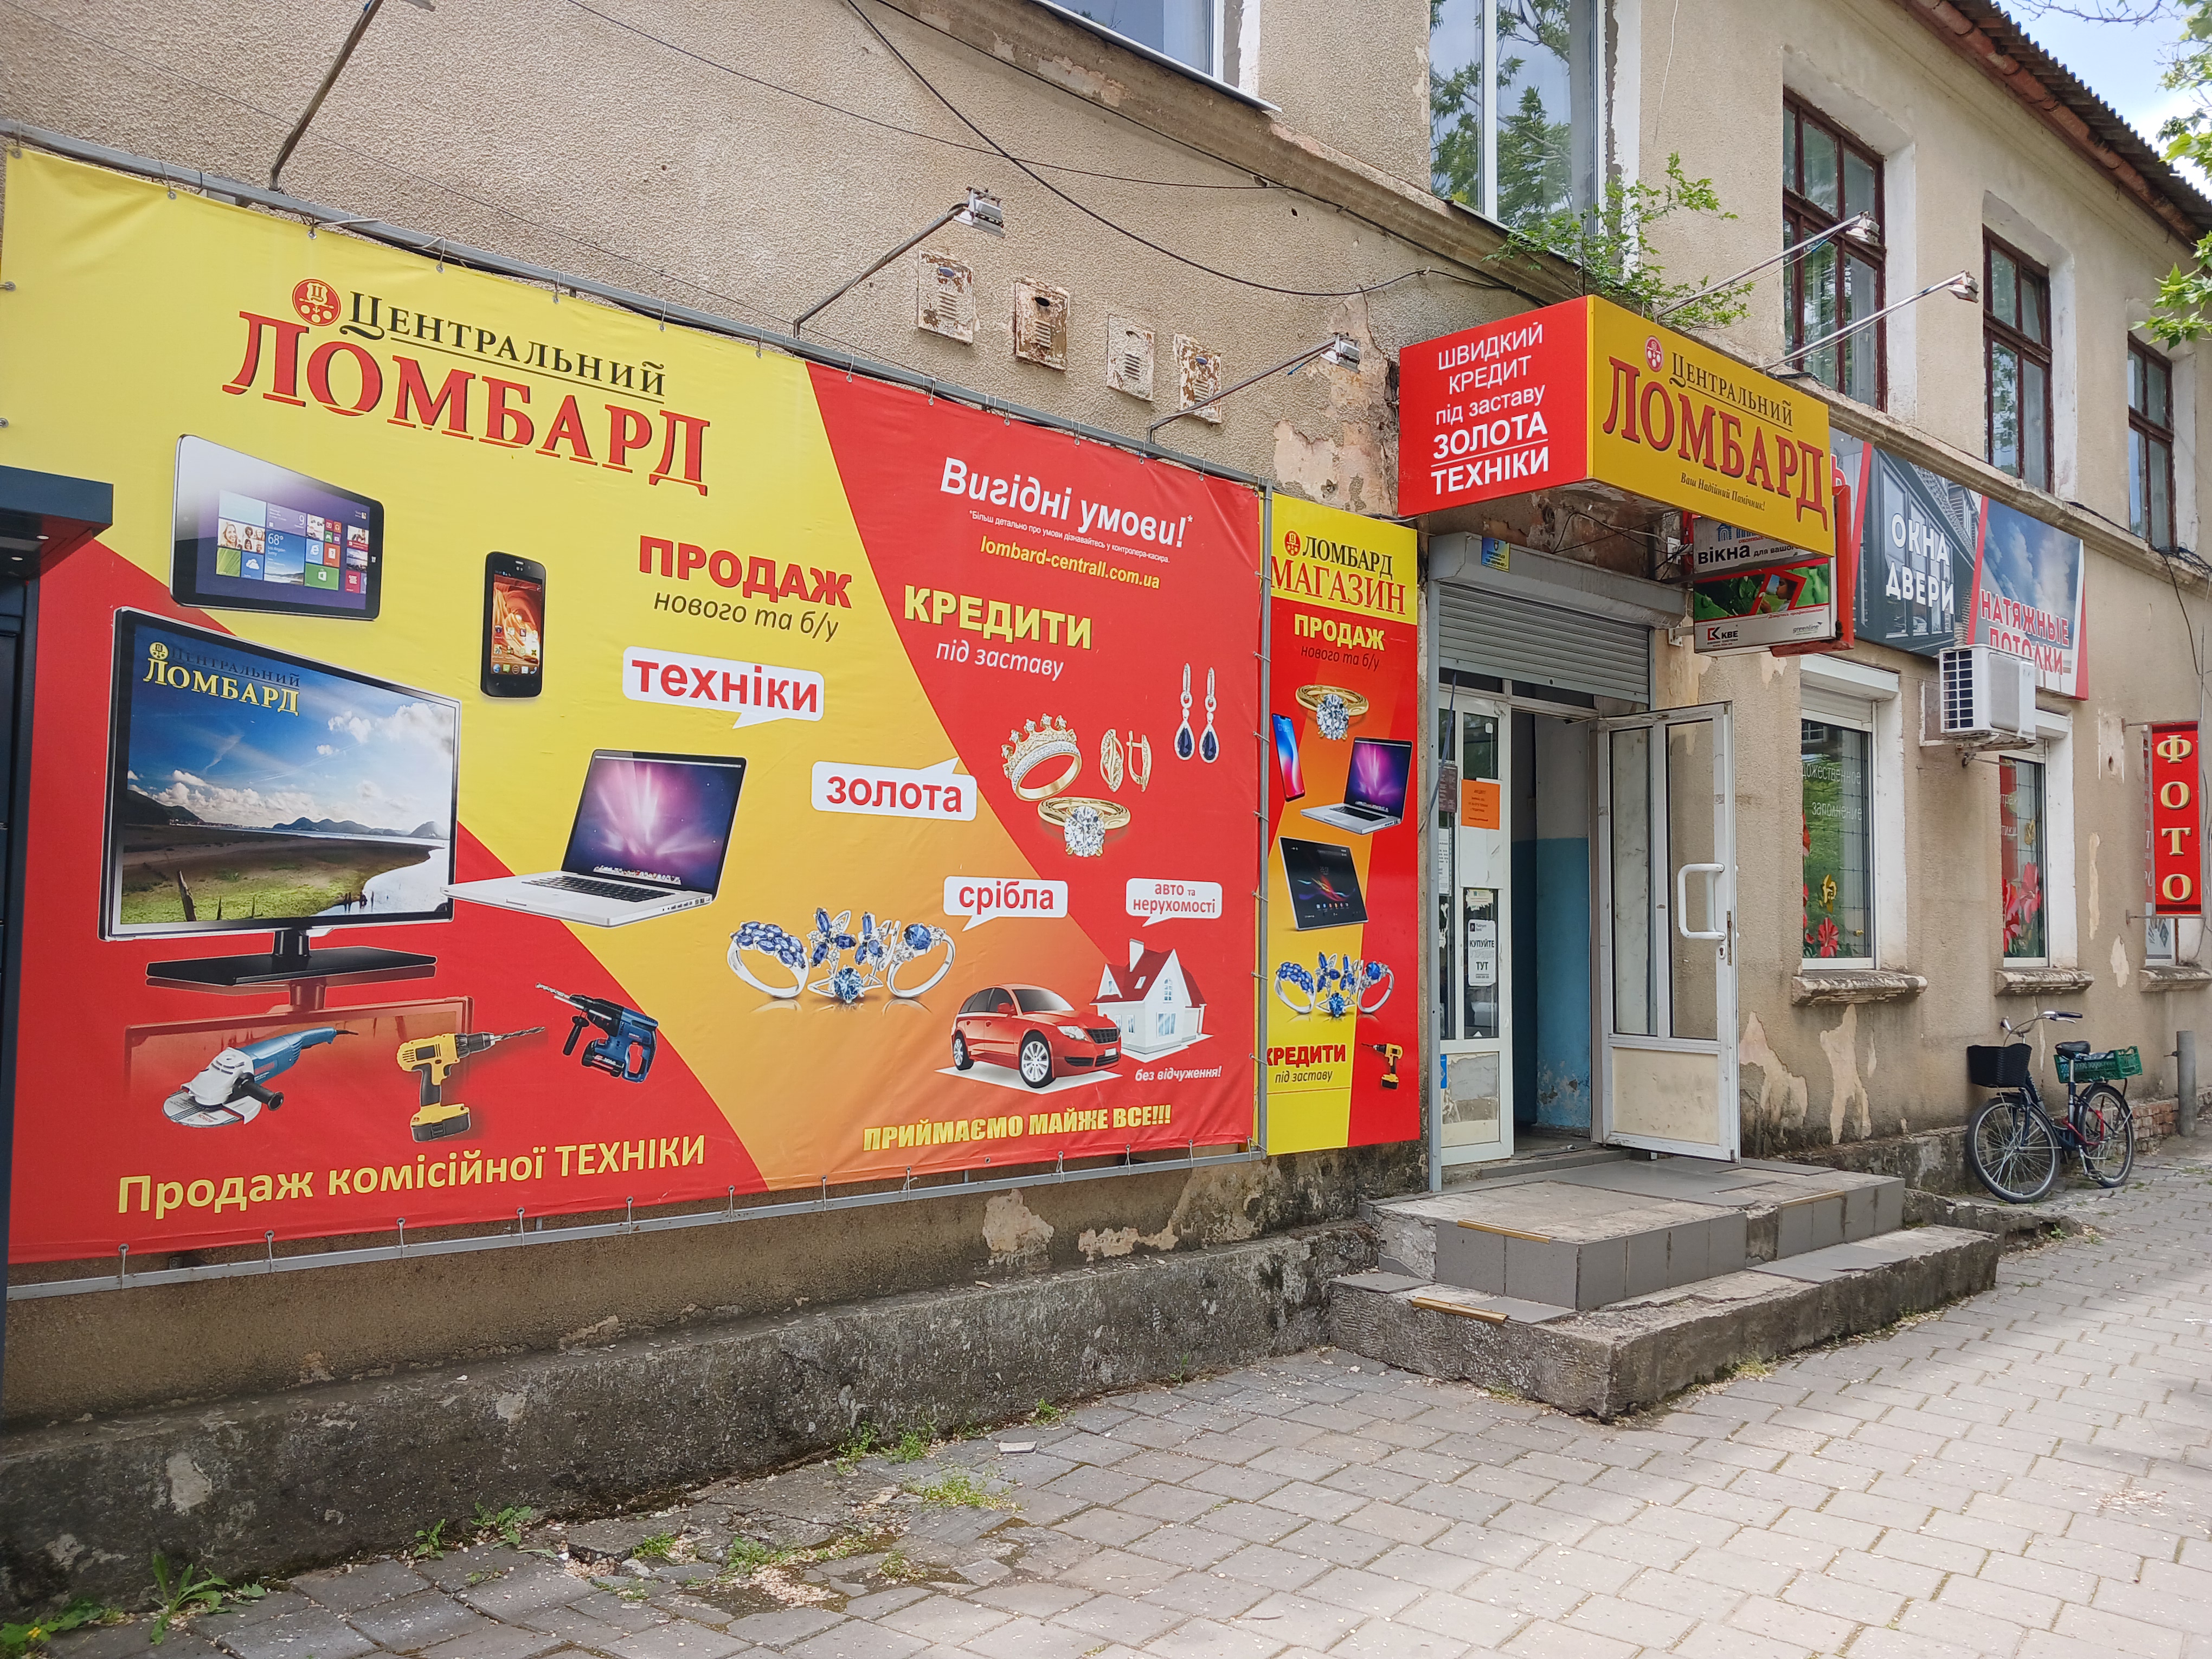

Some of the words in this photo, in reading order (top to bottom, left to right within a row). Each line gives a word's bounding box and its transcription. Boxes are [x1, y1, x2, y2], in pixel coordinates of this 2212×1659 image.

[339, 291, 666, 396] ЦЕНТРАЛЬНИЙ
[1438, 321, 1544, 371] ШВИДКИЙ
[1449, 355, 1532, 395] КРЕДИТ
[1669, 352, 1793, 427] ЦЕНТРАЛЬНИЙ
[222, 311, 711, 497] ЛОМБАРД
[1436, 404, 1463, 426] під
[1469, 384, 1545, 417] заставу
[1433, 411, 1548, 459] ЗОЛОТА
[1603, 356, 1828, 532] ЛОМБАРД
[940, 456, 1072, 520] Вигідні
[1431, 446, 1549, 495] ТЕХНІКИ
[1681, 472, 1696, 487] Ваш
[1698, 478, 1730, 499] Надійний
[1732, 490, 1765, 511] Помічник!
[995, 518, 1027, 531] детально
[1028, 525, 1041, 535] про
[1042, 528, 1063, 539] умови
[1064, 532, 1105, 549] дізнавайтесь
[1106, 542, 1111, 551] у
[1698, 545, 1751, 564] вікна
[1754, 549, 1769, 557] для
[1891, 513, 1950, 566] ОКНА
[639, 535, 852, 608] ПРОДАЖ
[980, 535, 1160, 589] lombard-centrall.com.ua
[1302, 536, 1393, 581] ЛОМБАРД
[1271, 556, 1406, 615] МАГАЗИН
[1886, 562, 1954, 615] ДВЕРИ
[654, 592, 747, 623] нового
[754, 608, 793, 631] та
[800, 610, 839, 642] б/у
[904, 584, 1092, 650] КРЕДИТИ
[1294, 614, 1385, 651] ПРОДАЖ
[1980, 588, 2070, 648] НАТЯЖНЫЕ
[170, 647, 300, 687] ЦЕНТРАЛЬНИЙ
[935, 639, 970, 663] під
[974, 648, 1065, 681] заставу
[1301, 646, 1340, 663] нового
[1342, 653, 1359, 665] та
[1362, 653, 1380, 672] б/у
[143, 658, 299, 716] ЛОМБАРД
[632, 659, 817, 712] техніки
[826, 775, 963, 813] золота
[1812, 802, 1862, 821] заполнение
[2157, 735, 2193, 902] ФОТО
[959, 880, 1054, 915] срібла
[1133, 898, 1215, 915] нерухомості
[1154, 883, 1185, 896] авто
[1470, 938, 1494, 948] КУПУЙТЕ
[1476, 962, 1488, 970] ТУТ
[1135, 1069, 1155, 1081] без
[1157, 1065, 1222, 1082] відчуження!
[1275, 1071, 1290, 1083] під
[1292, 1070, 1333, 1083] заставу
[863, 1116, 1024, 1151] ПРИЙМАЄМО
[1028, 1107, 1108, 1135] МАЙЖЕ
[1113, 1104, 1172, 1128] ВСЕ!!!
[118, 1168, 314, 1220] Продаж
[327, 1147, 544, 1195] комісійної
[554, 1134, 707, 1179] ТЕХНІКИ
